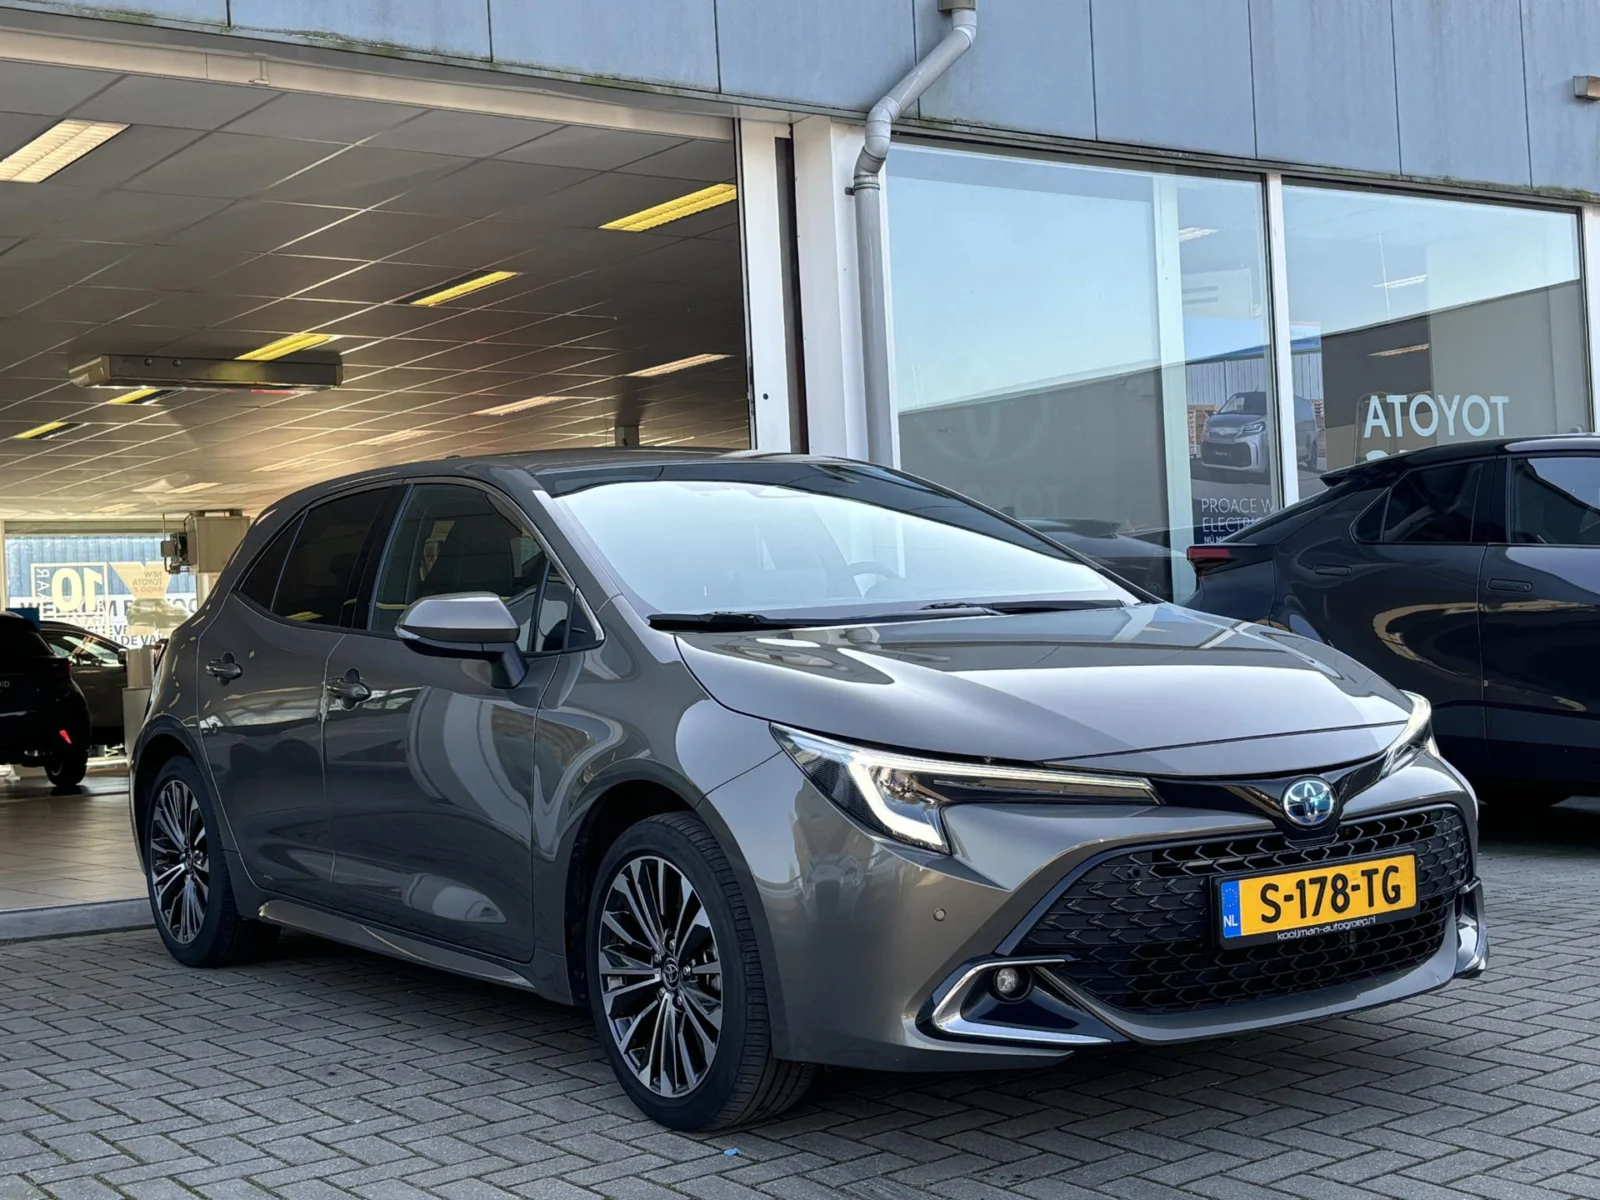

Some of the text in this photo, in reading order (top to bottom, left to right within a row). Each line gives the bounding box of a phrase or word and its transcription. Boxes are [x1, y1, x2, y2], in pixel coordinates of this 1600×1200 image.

[1201, 497, 1257, 513] PROACE
[1260, 865, 1401, 923] S-178-TG
[1223, 914, 1238, 928] NL
[1277, 915, 1376, 940] kooijman-autogroep.nl
